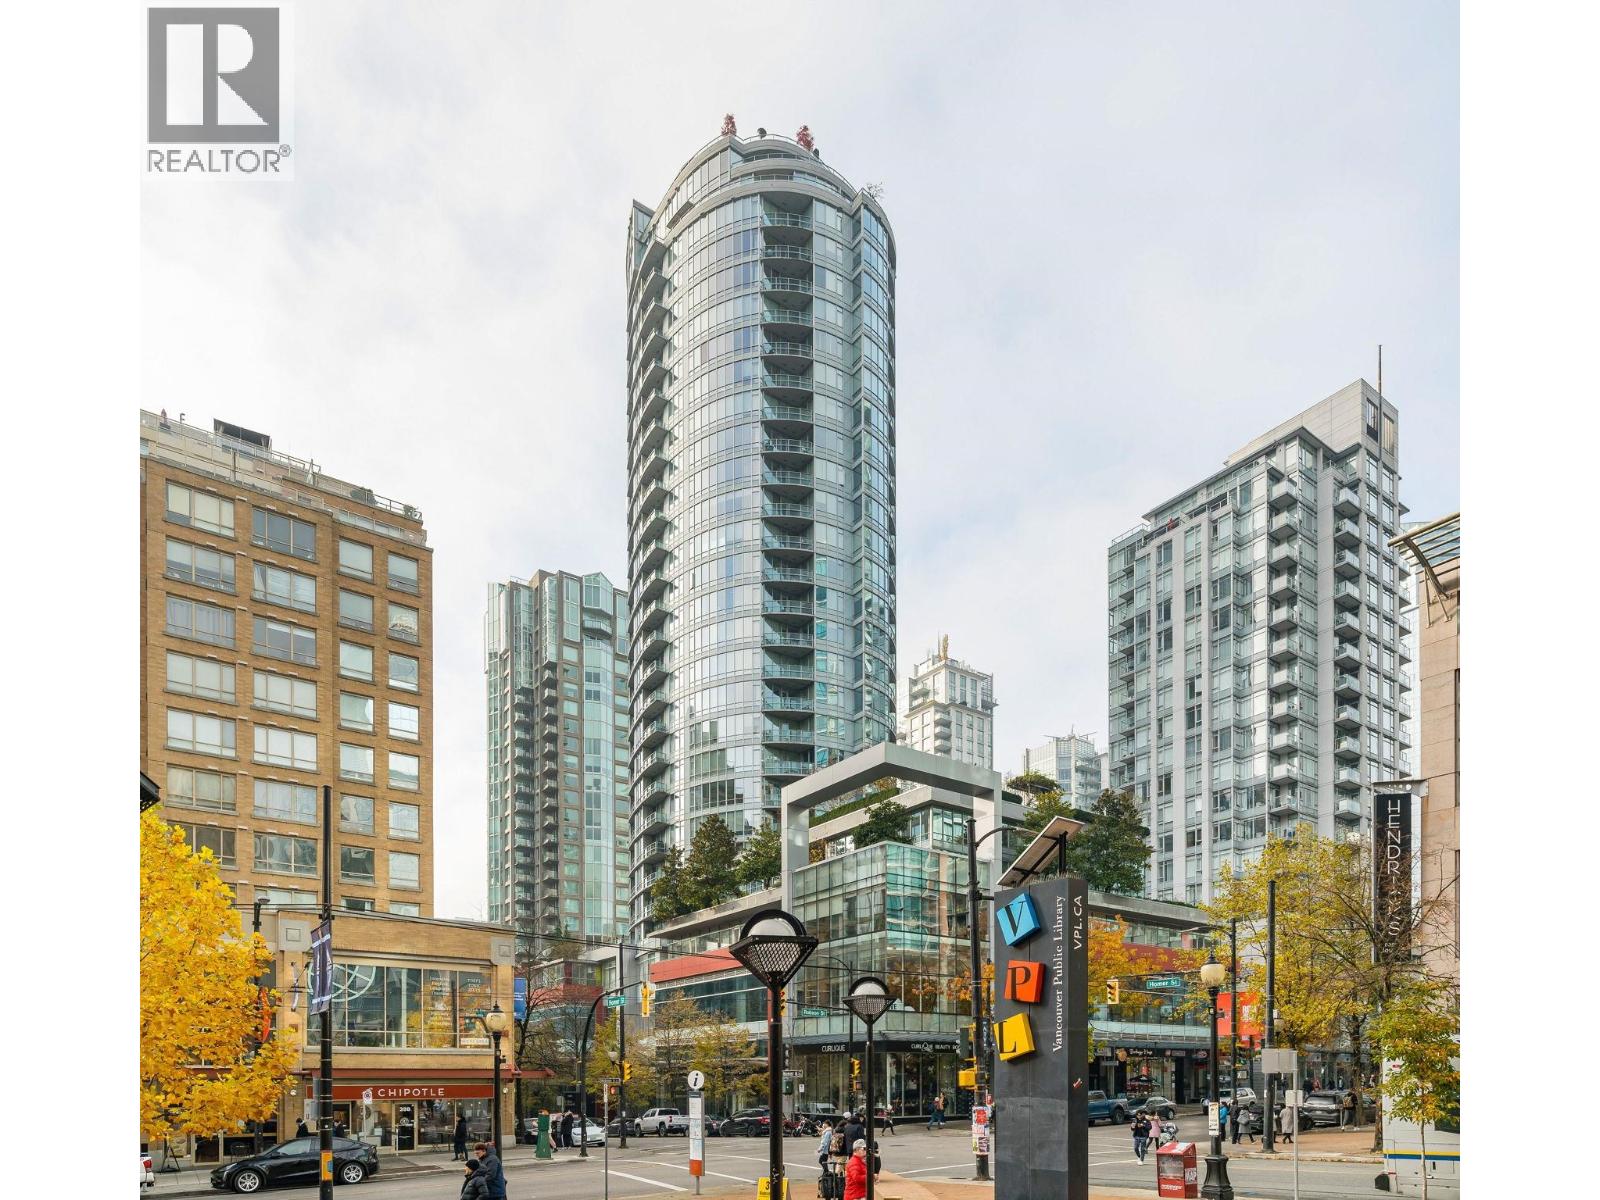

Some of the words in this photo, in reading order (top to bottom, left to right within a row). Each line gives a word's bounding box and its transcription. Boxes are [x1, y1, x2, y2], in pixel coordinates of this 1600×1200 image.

[1052, 895, 1067, 942] Library
[1073, 895, 1083, 950] VPL.CA
[1052, 945, 1063, 986] Public
[1149, 980, 1168, 988] Homer
[1052, 989, 1063, 1053] Vancouver
[377, 1087, 446, 1097] CHIPOTLE
